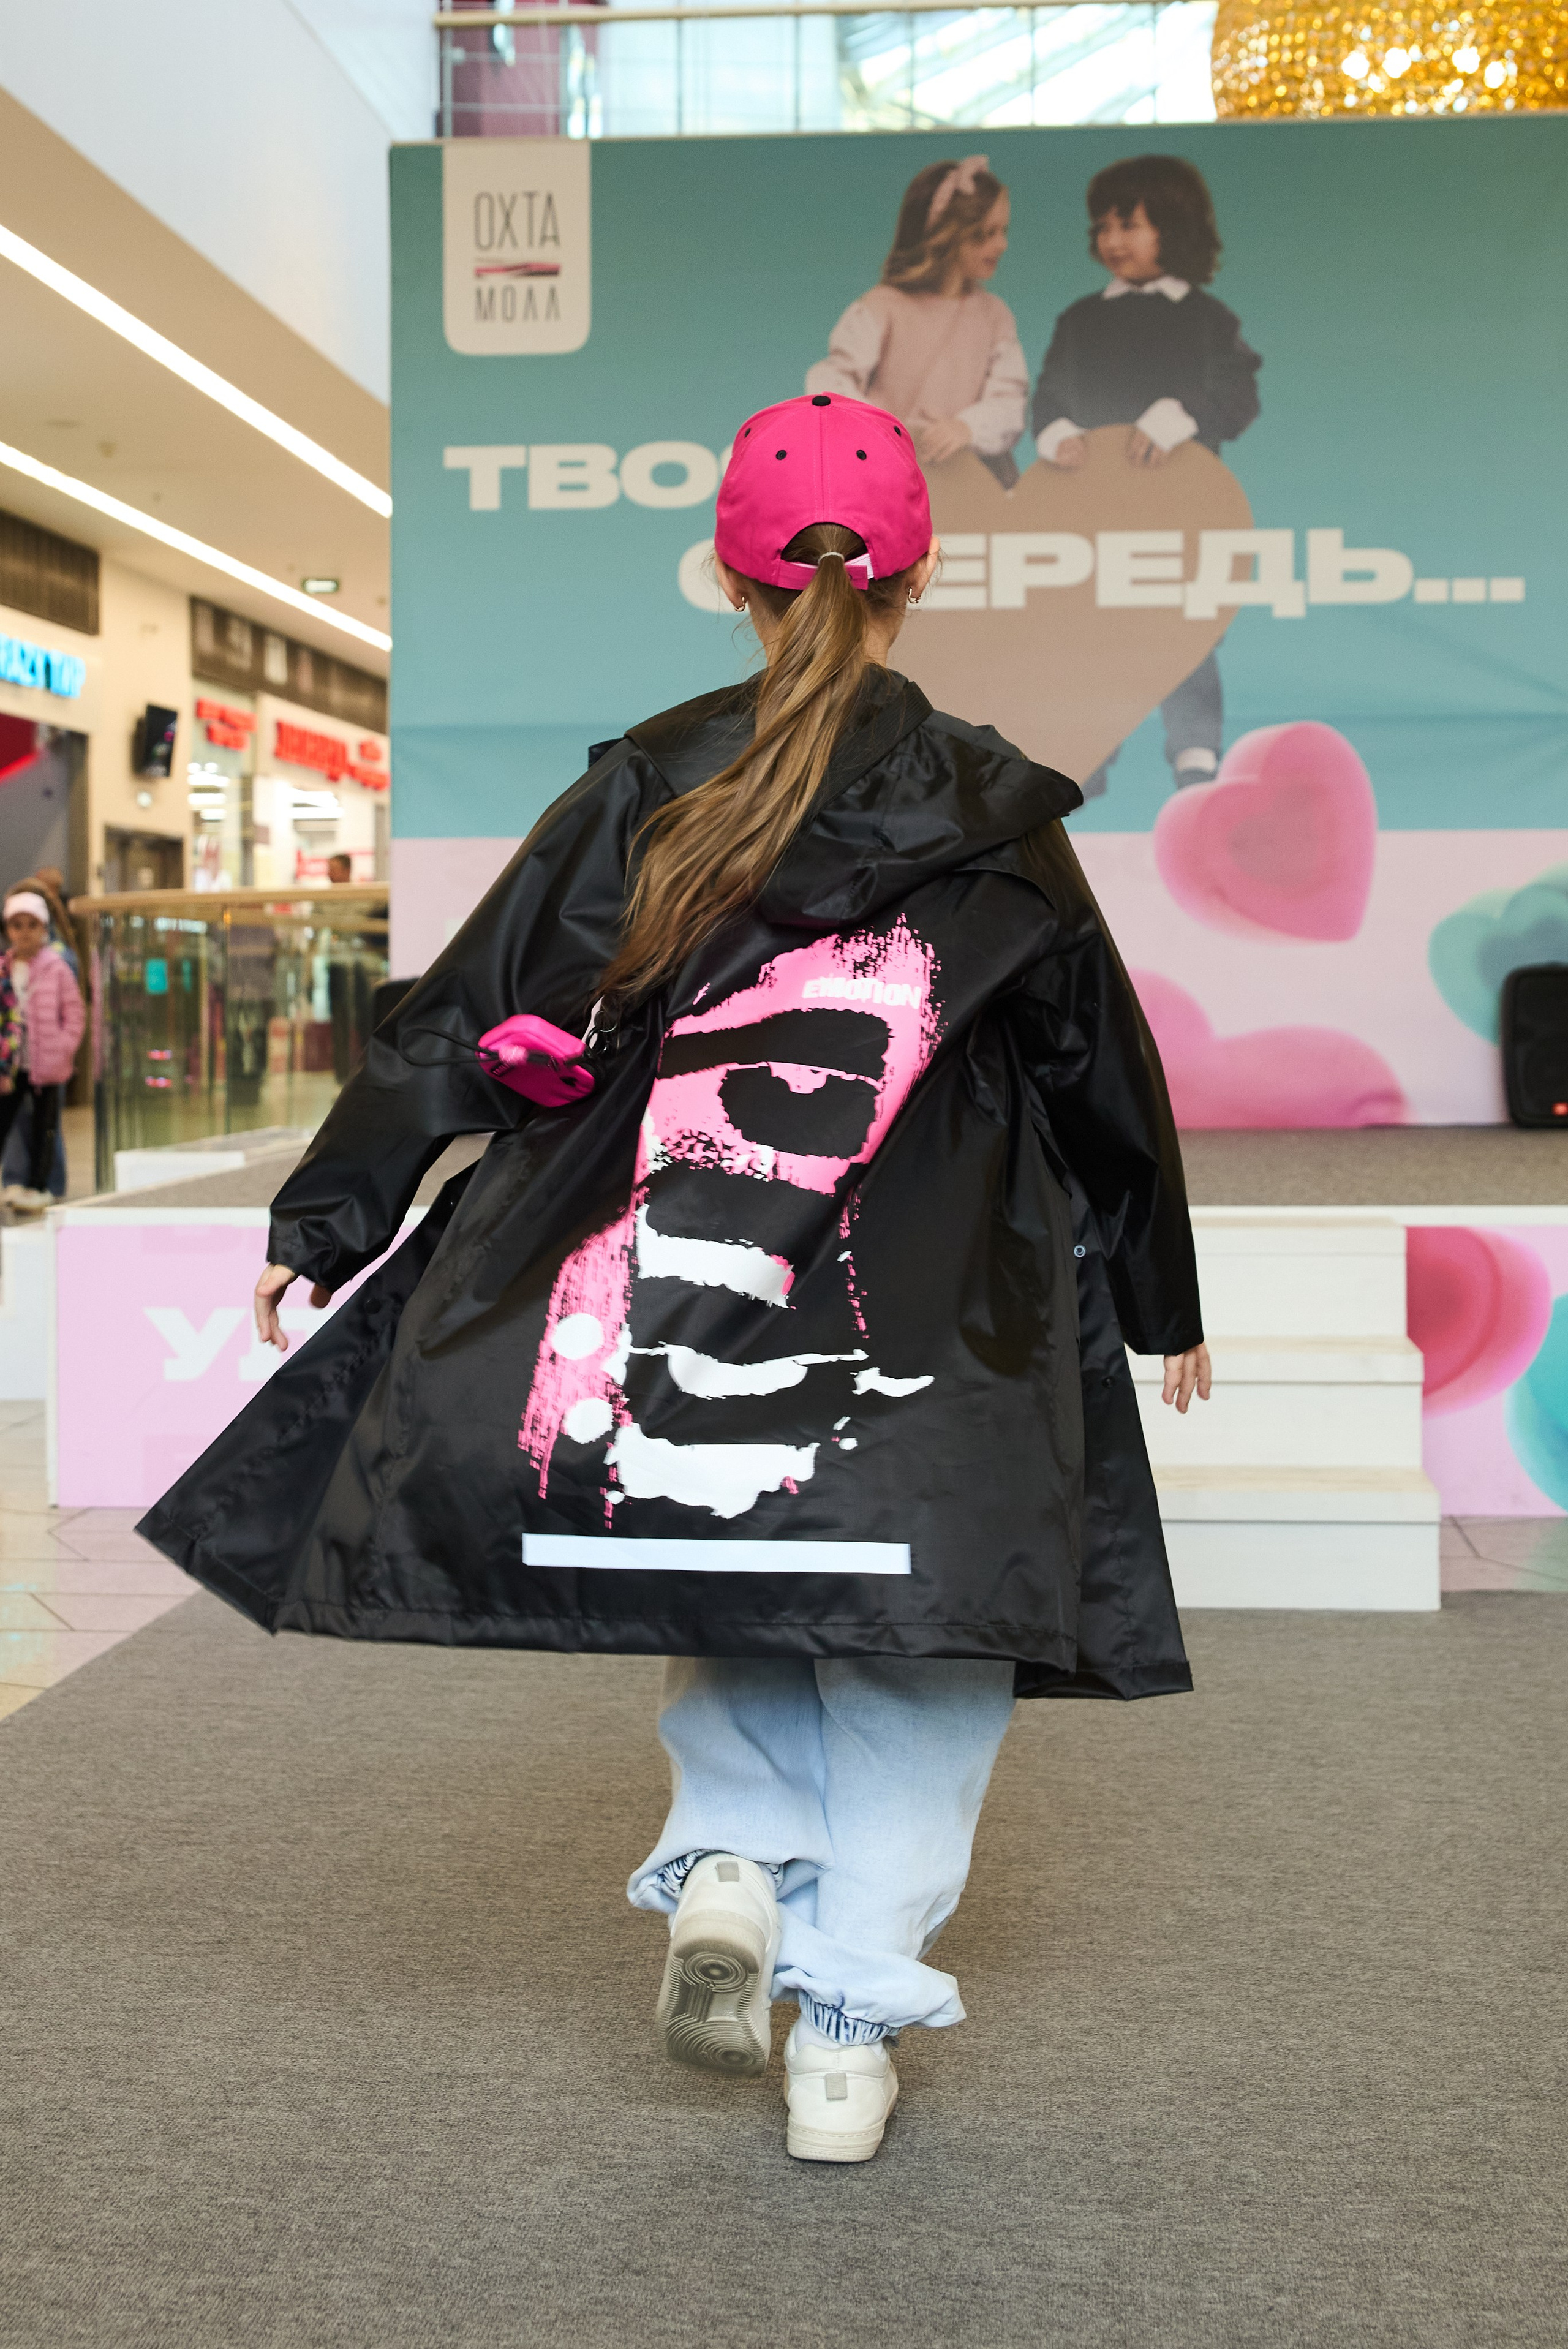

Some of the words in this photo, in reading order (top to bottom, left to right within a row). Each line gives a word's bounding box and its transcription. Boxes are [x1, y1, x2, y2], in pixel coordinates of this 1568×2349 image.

[473, 190, 561, 250] ОХТА
[473, 284, 562, 322] МОЛЛ
[443, 440, 733, 511] ТВО
